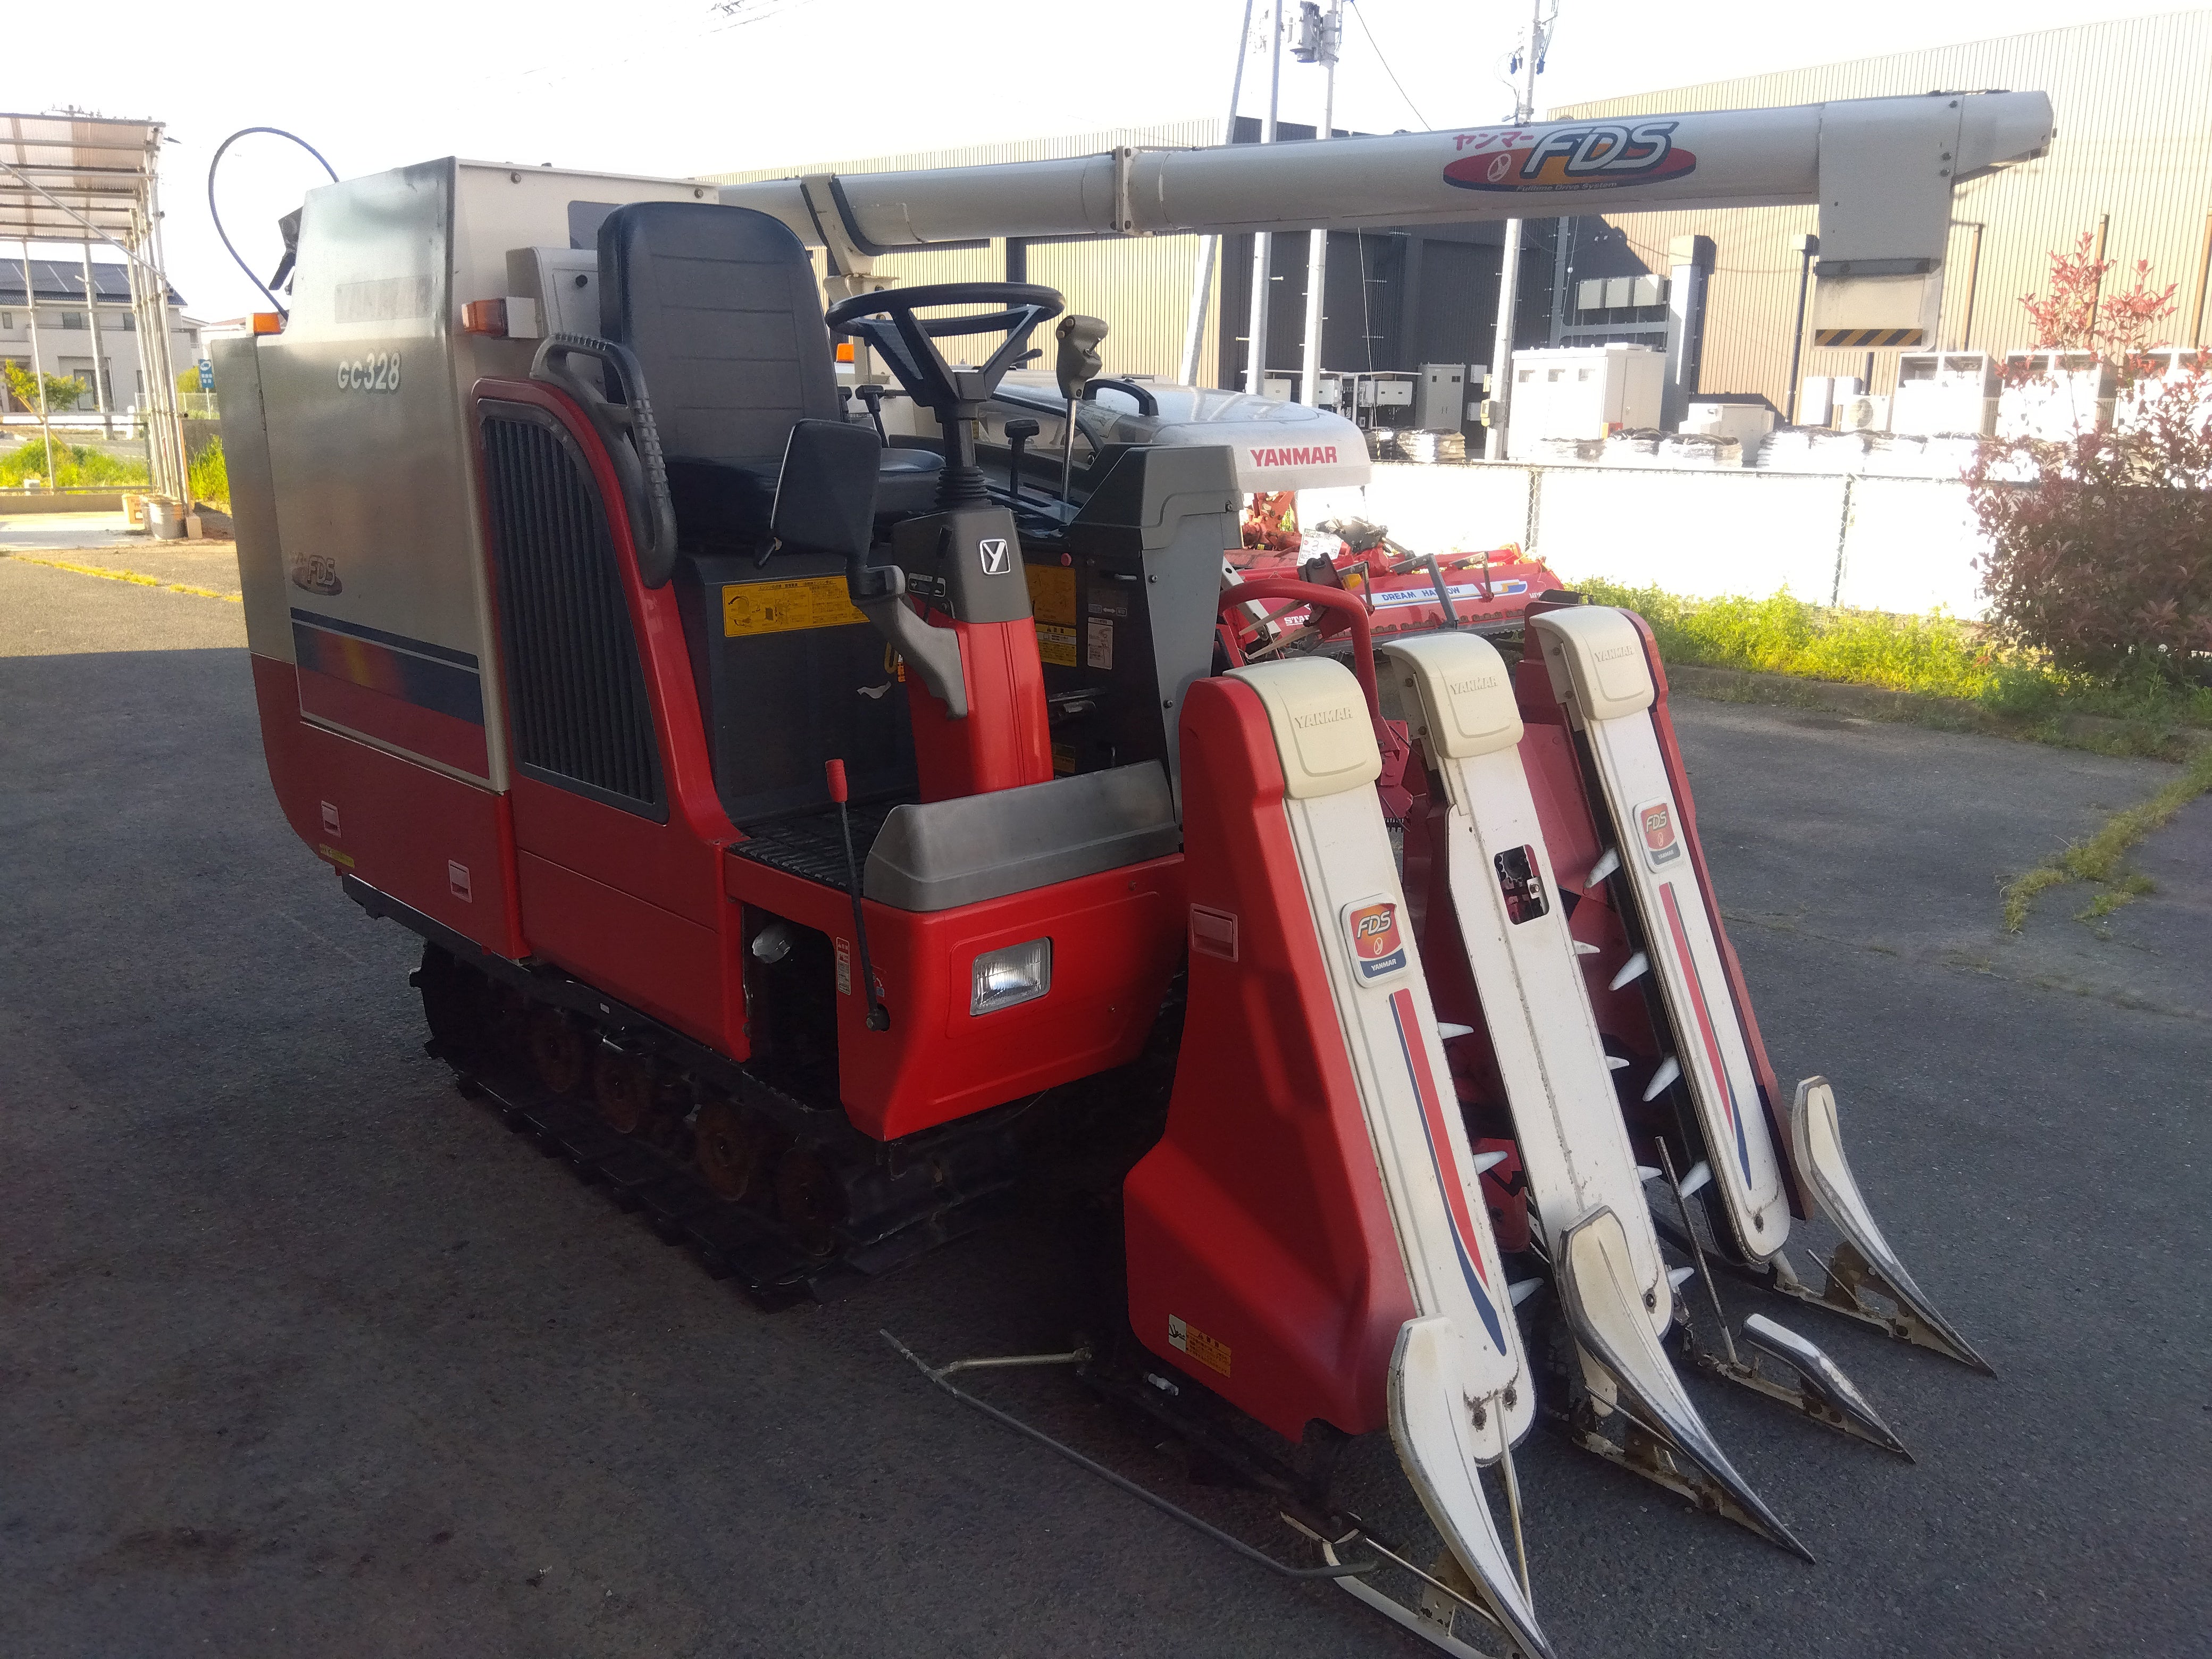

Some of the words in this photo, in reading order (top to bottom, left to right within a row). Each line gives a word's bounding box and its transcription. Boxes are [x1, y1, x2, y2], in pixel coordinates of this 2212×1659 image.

[1453, 131, 1534, 151] ヤンマー
[1519, 121, 1679, 179] FDS
[338, 353, 400, 390] GC328
[1250, 446, 1337, 467] YANMAR
[1381, 591, 1416, 601] DREAM
[1595, 646, 1634, 663] YANMAR
[1449, 676, 1498, 695] YANMAR
[1294, 706, 1354, 729] YANMAR
[1646, 810, 1668, 834] FDS
[1357, 910, 1392, 939] FDS
[1371, 959, 1397, 971] YANMAR
